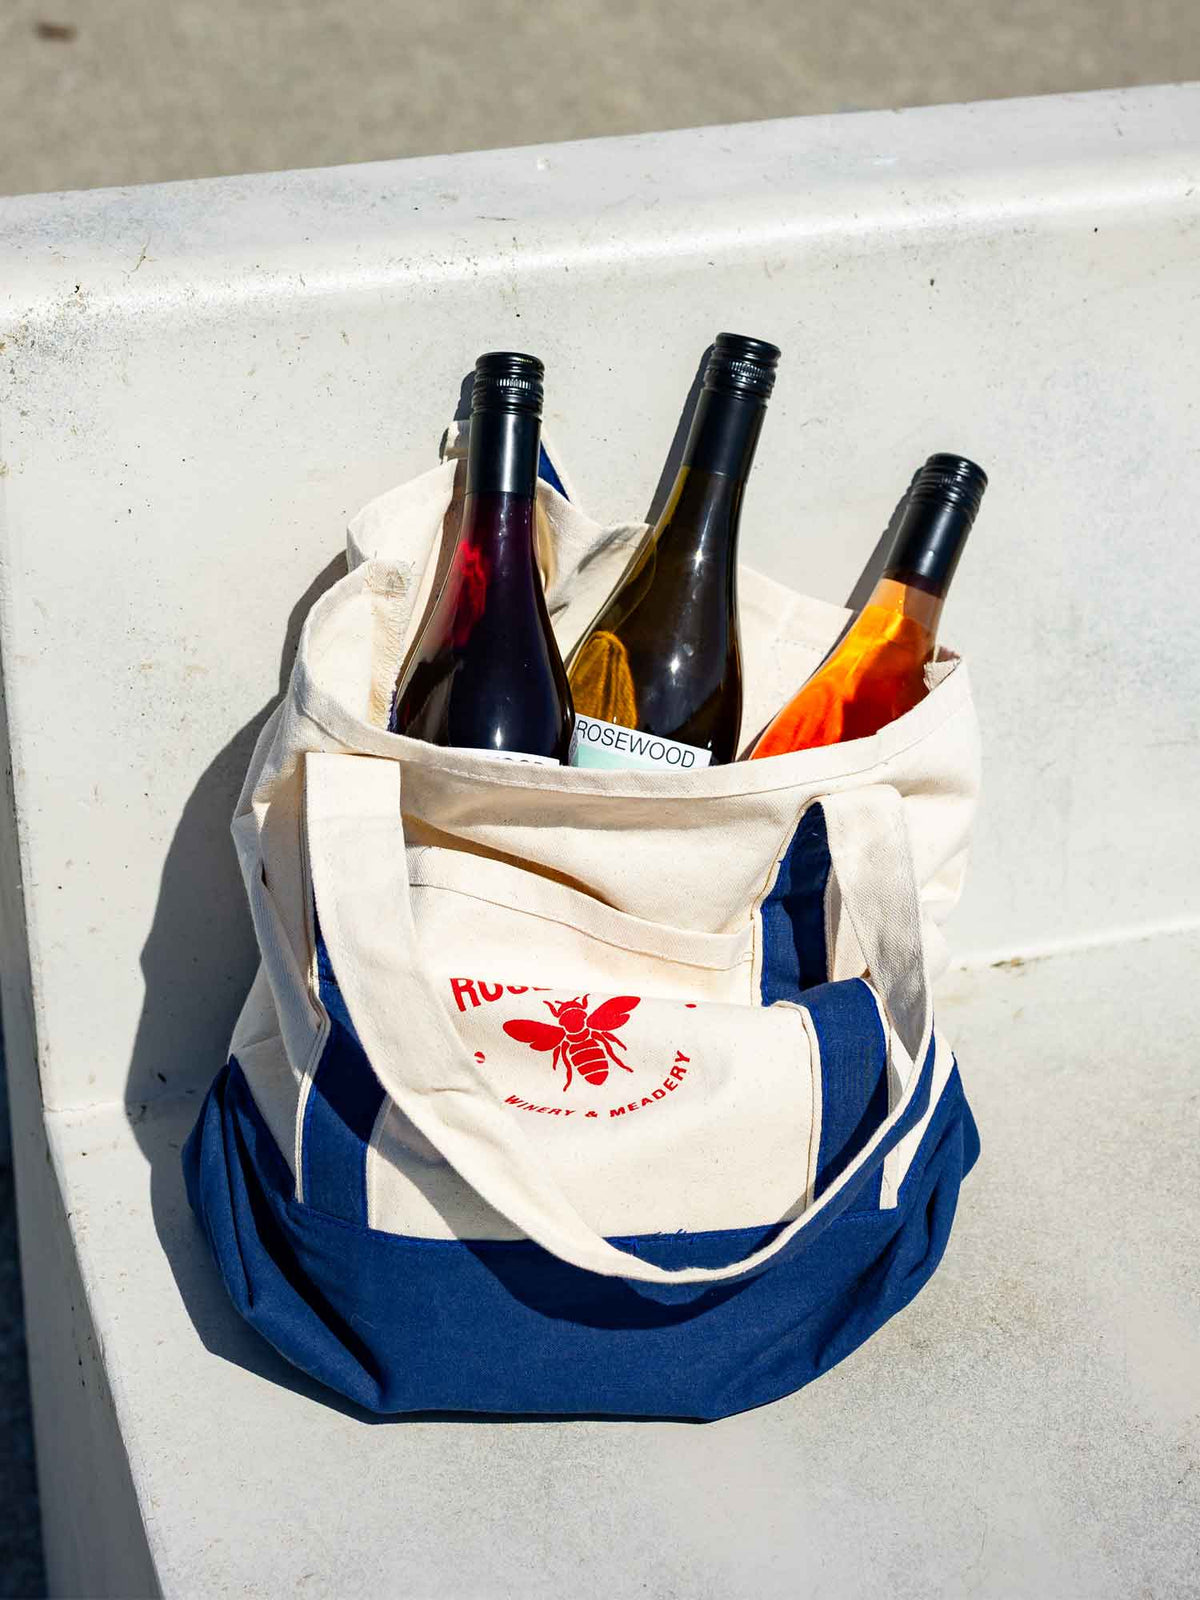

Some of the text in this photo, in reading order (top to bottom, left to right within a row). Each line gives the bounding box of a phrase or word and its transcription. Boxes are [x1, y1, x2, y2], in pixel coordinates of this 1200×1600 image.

[576, 719, 695, 768] ROSEWOOD
[504, 1050, 691, 1118] WINERY & MEADERY
